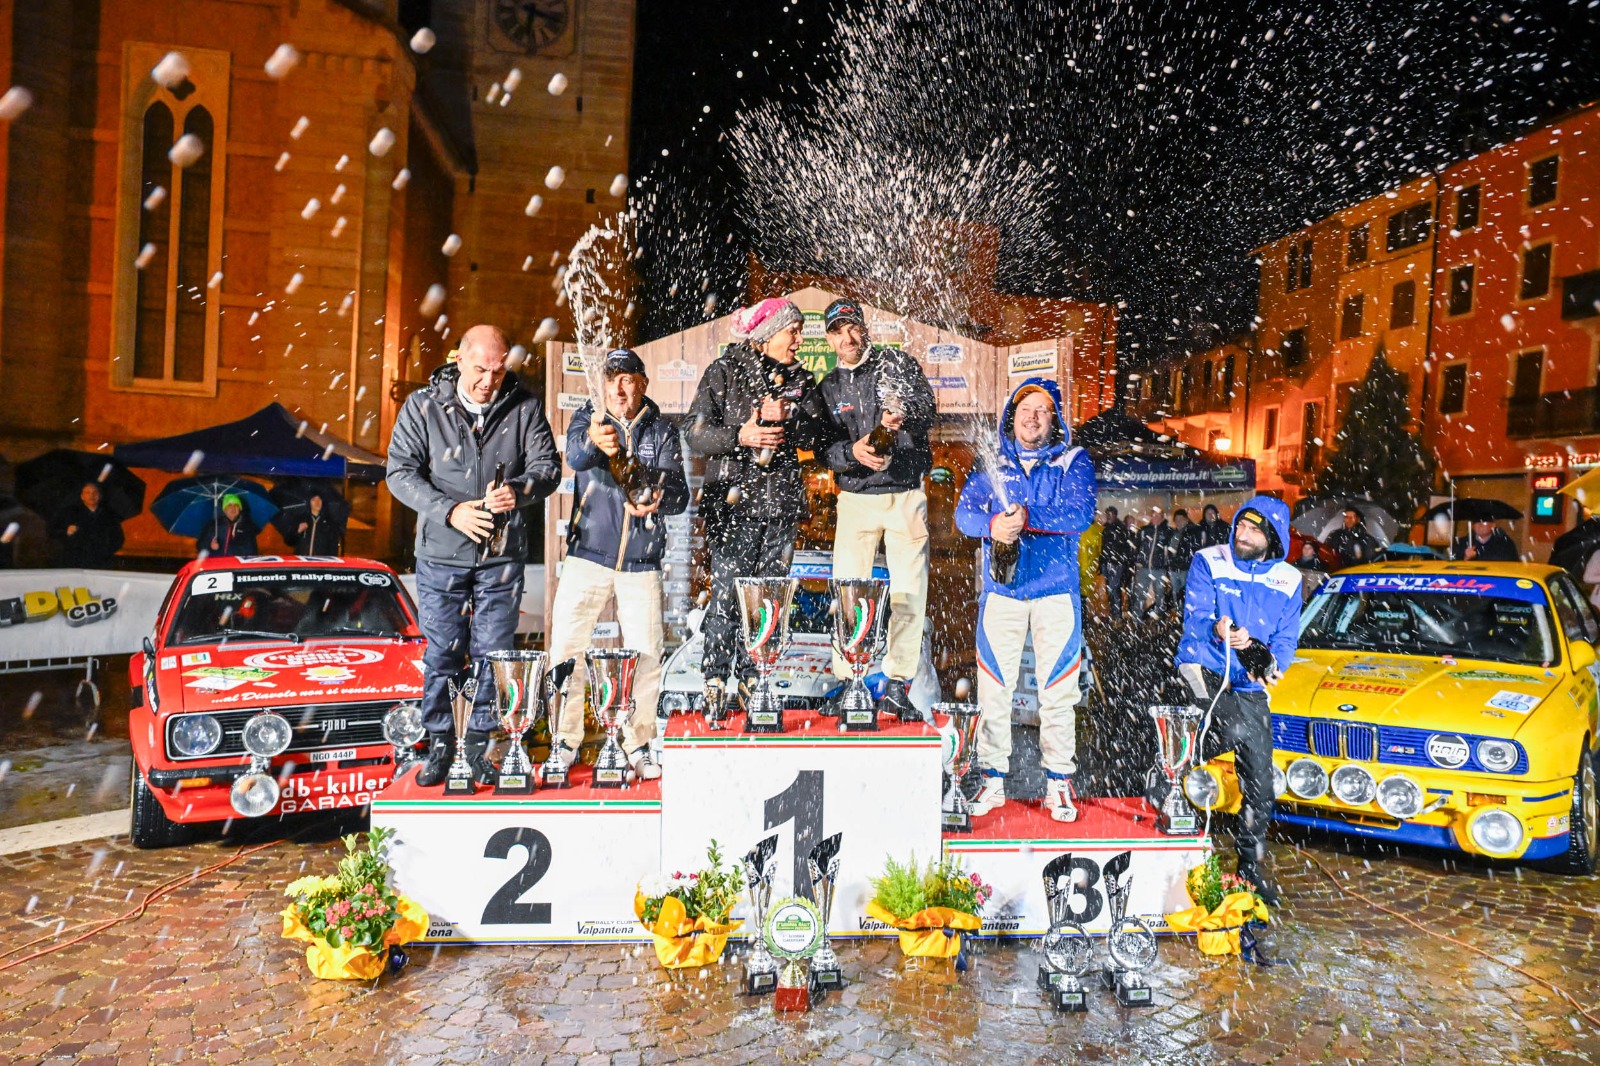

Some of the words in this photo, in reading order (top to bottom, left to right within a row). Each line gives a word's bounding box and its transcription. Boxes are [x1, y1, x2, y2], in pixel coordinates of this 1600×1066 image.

[797, 344, 836, 353] pantena
[1012, 356, 1051, 369] Valpantena
[207, 577, 218, 589] 2
[237, 573, 287, 583] Historic
[291, 573, 356, 582] RallySport
[1355, 577, 1449, 587] PINTA
[1327, 579, 1339, 591] 4
[67, 597, 118, 622] CDP
[242, 686, 298, 702] Diavolo
[300, 688, 324, 697] non
[327, 686, 339, 695] si
[382, 684, 393, 694] si
[322, 719, 347, 731] FORD
[312, 751, 330, 761] NGO
[332, 750, 354, 760] 444P
[281, 772, 388, 798] db-killer
[763, 770, 824, 903] 1
[480, 827, 552, 926] 2
[1063, 857, 1104, 924] 3
[577, 920, 634, 937] Valpantena
[858, 916, 897, 931] Valpan
[980, 921, 1020, 931] antena
[425, 928, 453, 938] tena
